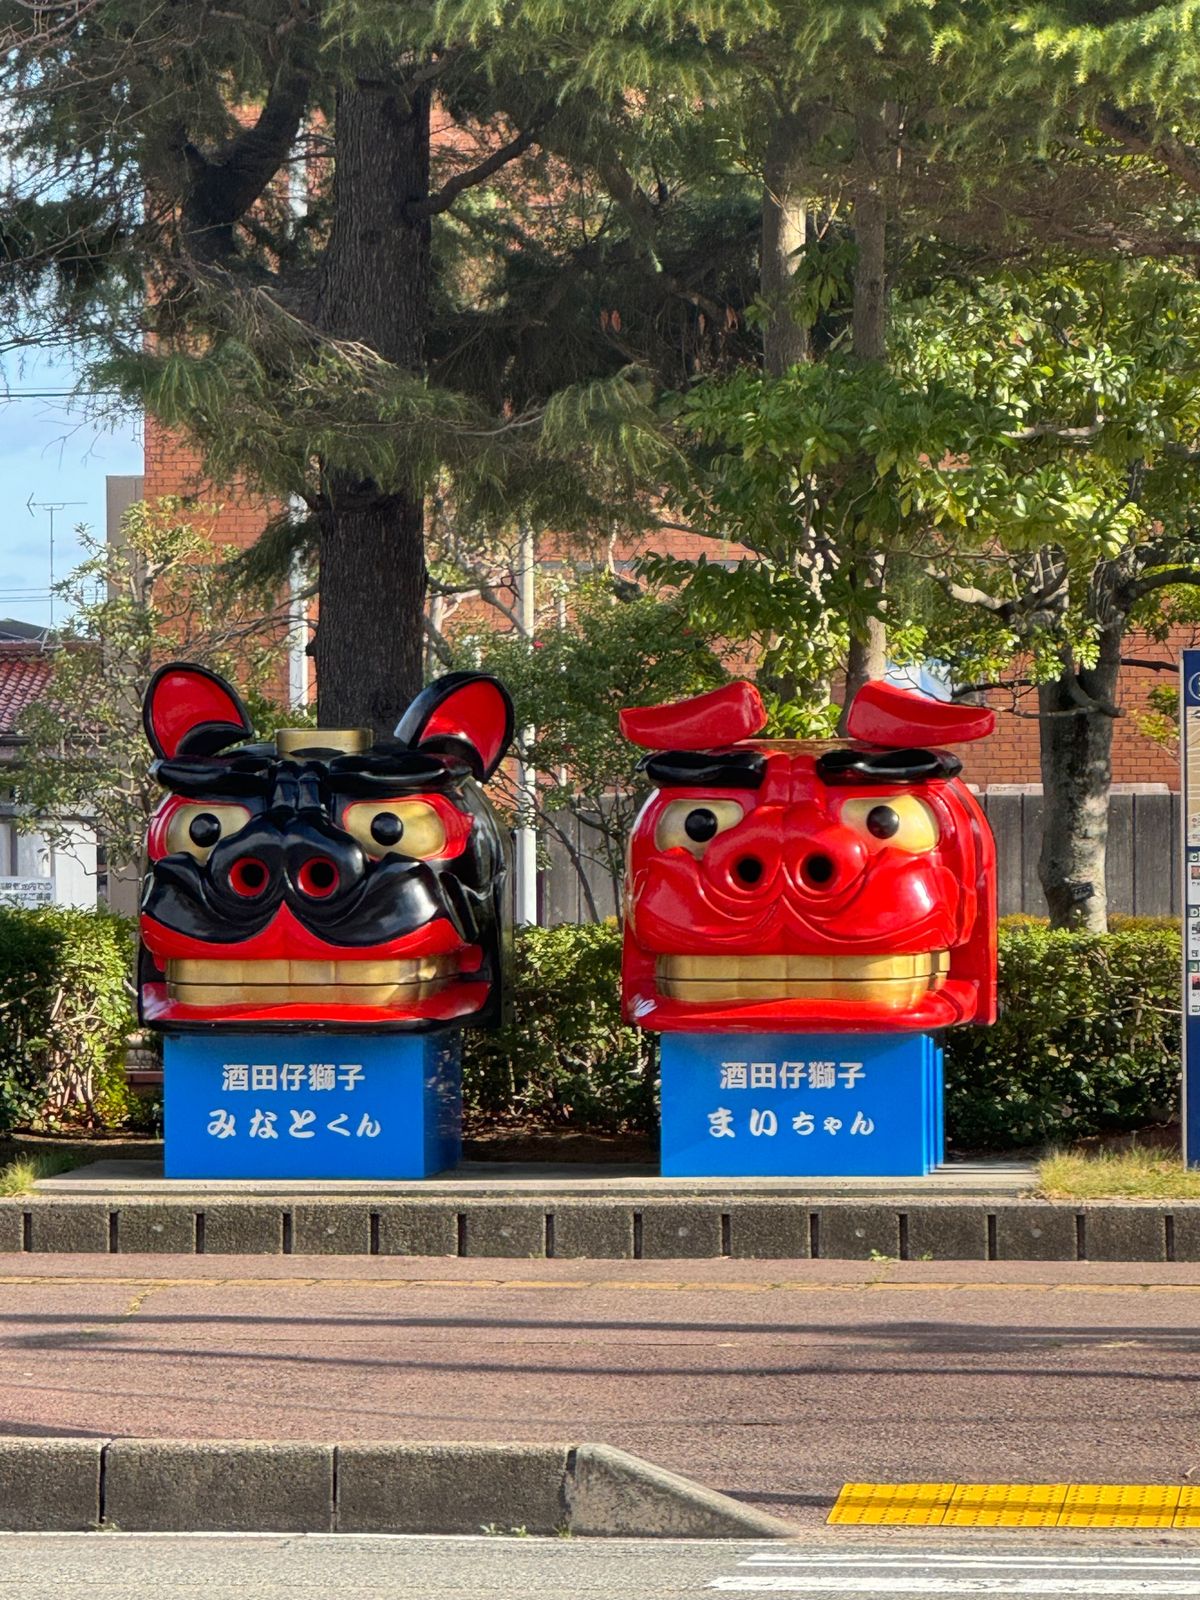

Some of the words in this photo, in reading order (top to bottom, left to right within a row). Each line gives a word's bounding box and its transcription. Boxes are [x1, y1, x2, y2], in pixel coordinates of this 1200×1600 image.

[223, 1064, 364, 1090] 酒田仔獅子
[720, 1062, 865, 1089] 酒田仔獅子
[208, 1109, 380, 1138] みなとくん
[708, 1108, 874, 1137] まいちゃん
